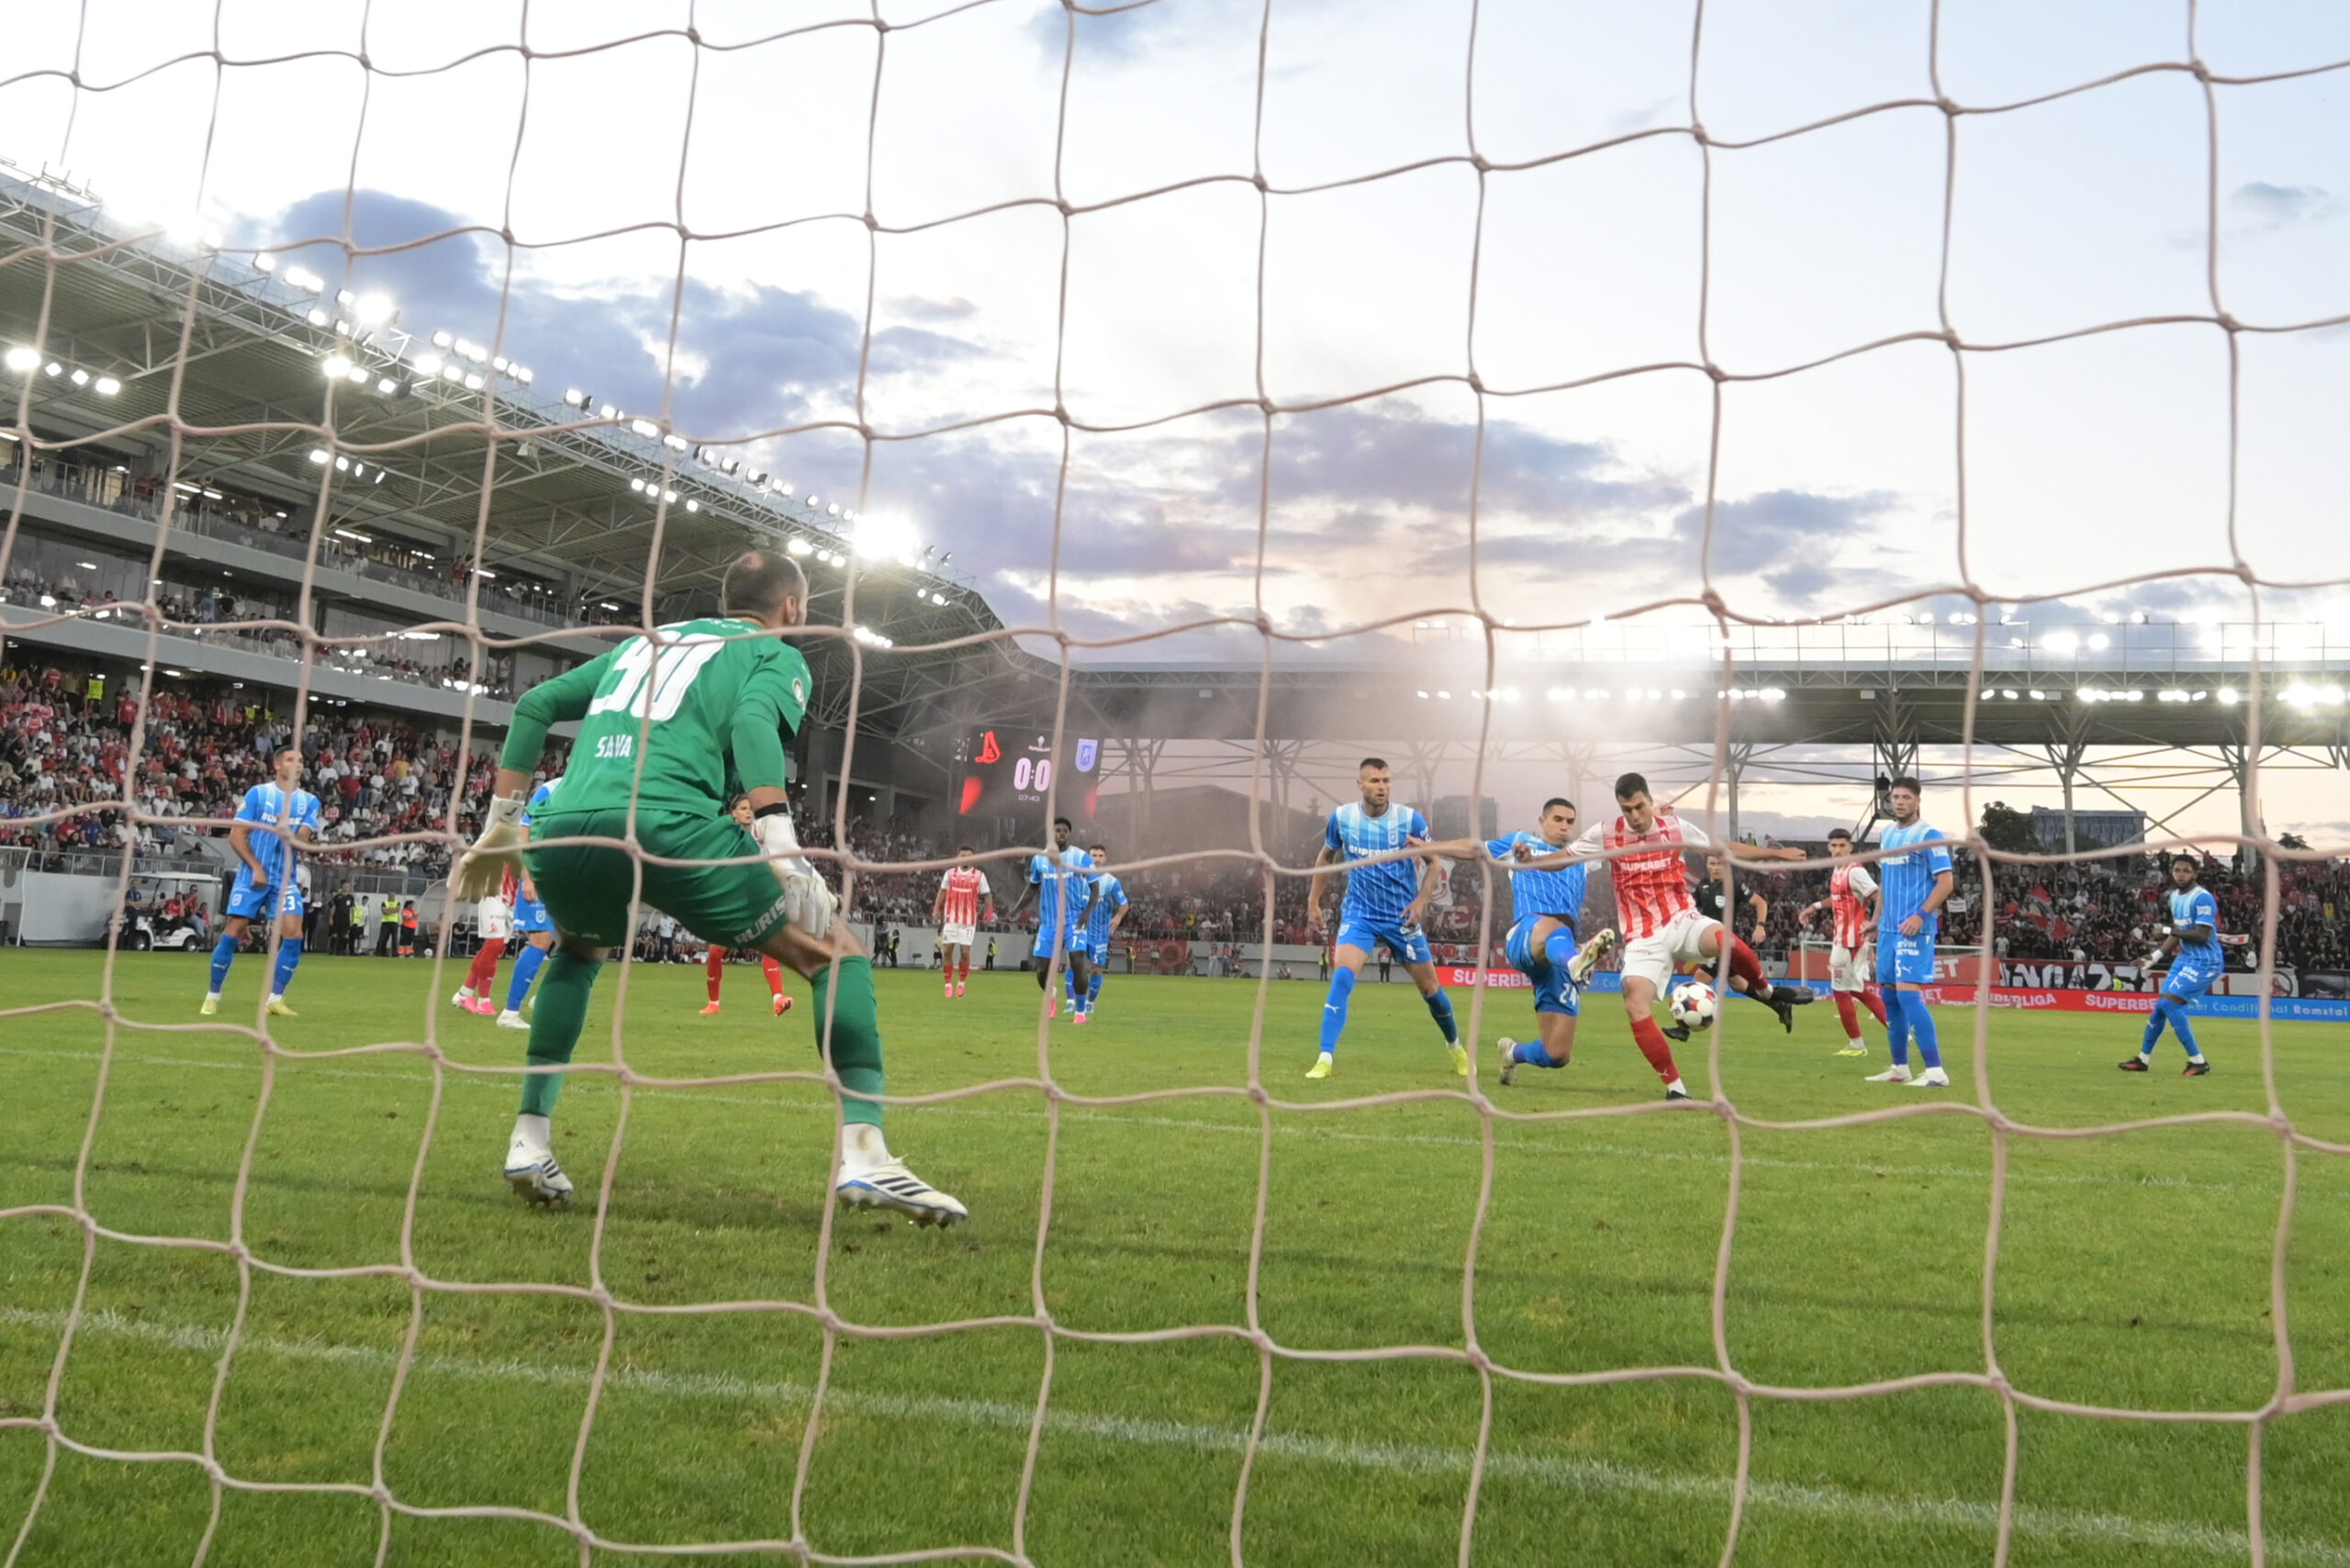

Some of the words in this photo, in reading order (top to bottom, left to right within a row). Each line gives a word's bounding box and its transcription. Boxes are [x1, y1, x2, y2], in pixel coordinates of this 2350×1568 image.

[595, 734, 633, 758] SAVA
[1013, 757, 1052, 791] 0:0
[1621, 857, 1672, 871] SUPERBET
[1453, 969, 1533, 988] SUERBE
[2085, 993, 2159, 1011] SUPERBE
[2294, 1005, 2348, 1017] Romstal
